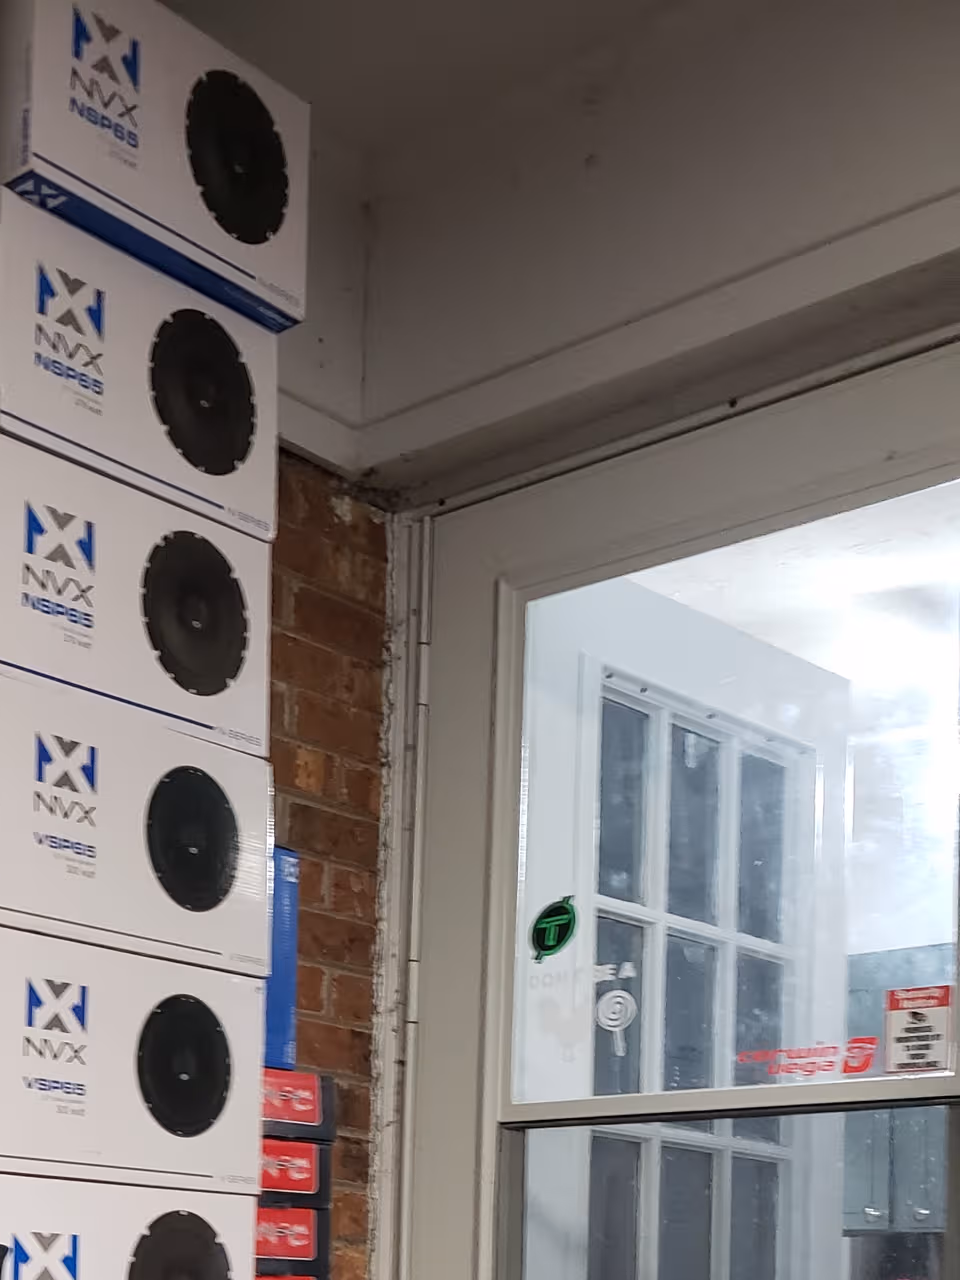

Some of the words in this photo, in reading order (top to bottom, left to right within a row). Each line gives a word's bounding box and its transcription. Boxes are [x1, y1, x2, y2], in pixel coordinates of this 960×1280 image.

[69, 66, 138, 128] NVX
[69, 97, 139, 149] NSP65
[34, 322, 104, 377] NVX
[34, 352, 105, 396] NSP65
[22, 562, 95, 609] NVX
[32, 790, 96, 828] NVX
[22, 1035, 88, 1066] NVX
[22, 1075, 87, 1097] VSP65
